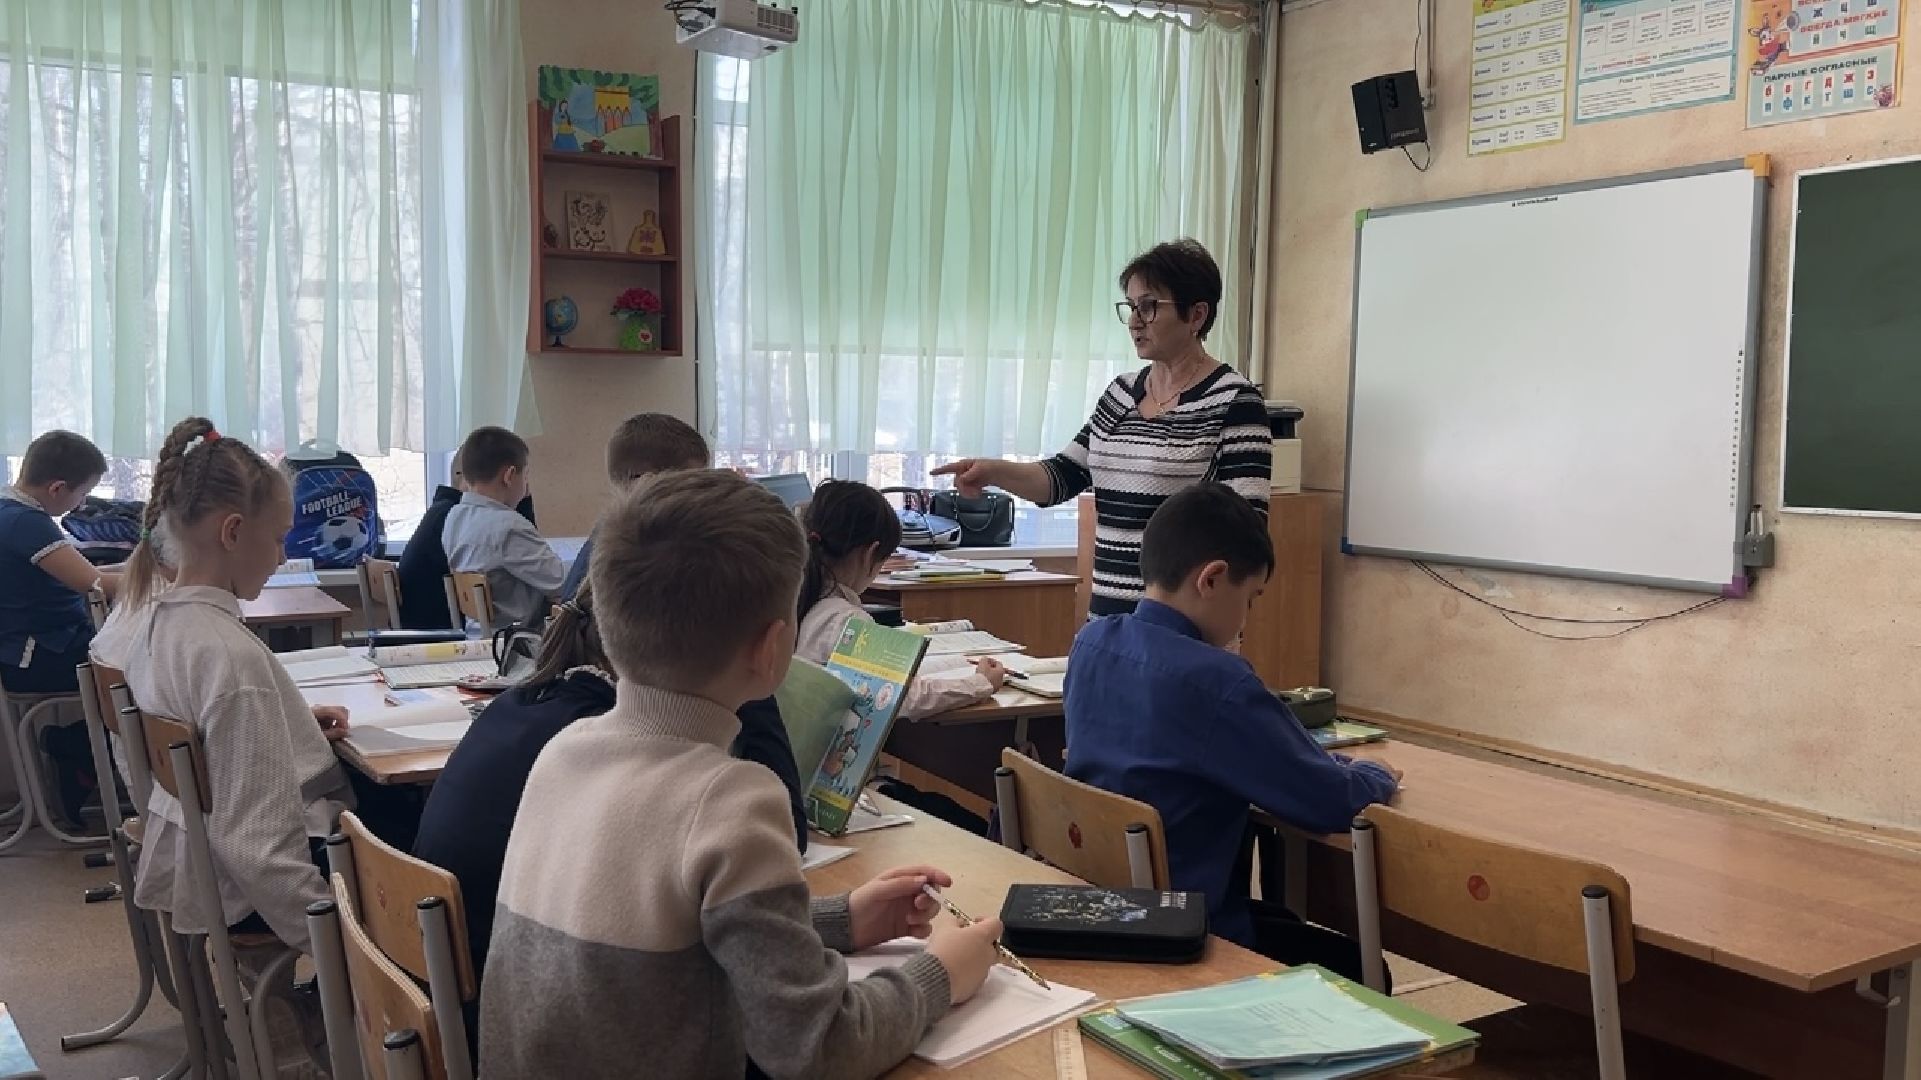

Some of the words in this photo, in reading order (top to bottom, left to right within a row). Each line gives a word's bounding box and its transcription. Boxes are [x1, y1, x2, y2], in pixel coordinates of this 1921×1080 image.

[1764, 69, 1808, 83] ПАРНЫЕ
[1810, 55, 1878, 74] СОГЛАСНЫЕ
[302, 490, 350, 514] FOOTBALL
[326, 496, 362, 517] LEAGUE
